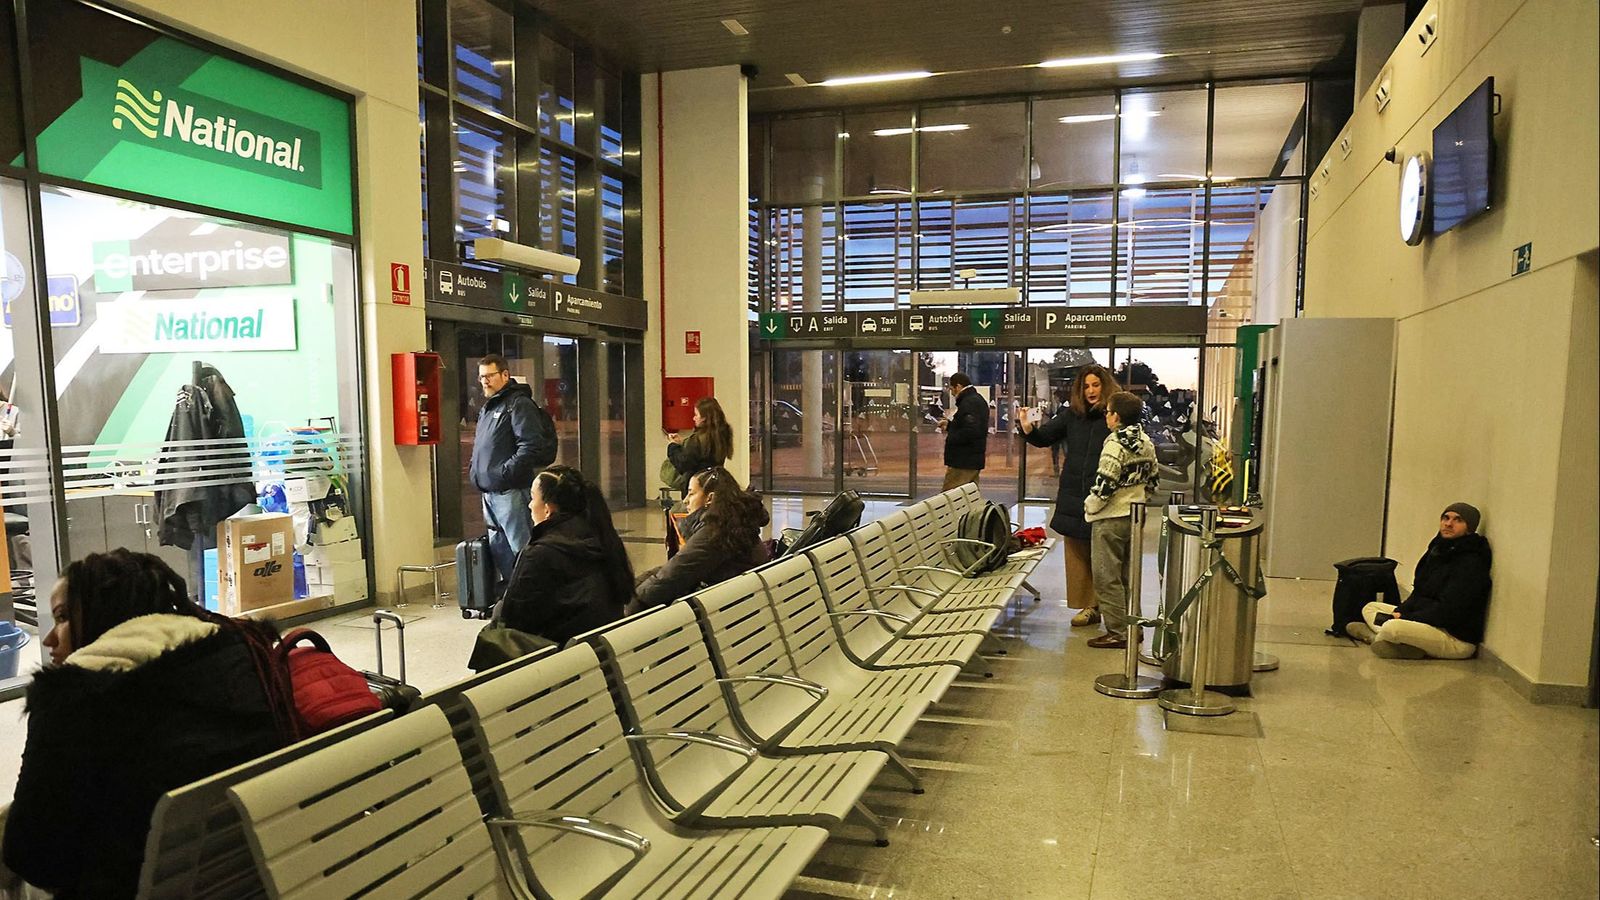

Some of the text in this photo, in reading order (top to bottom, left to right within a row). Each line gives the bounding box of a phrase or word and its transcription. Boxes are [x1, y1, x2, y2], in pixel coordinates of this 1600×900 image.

[102, 241, 288, 280] enterprise
[457, 273, 487, 289] Autobús
[527, 286, 547, 299] Salida
[555, 291, 603, 312] P Aparcamiento
[154, 309, 264, 341] National
[808, 316, 848, 332] A Salida
[881, 316, 897, 325] Taxi
[928, 313, 963, 323] Autobús
[1004, 313, 1031, 322] Salida
[1045, 312, 1127, 330] P Aparcamiento
